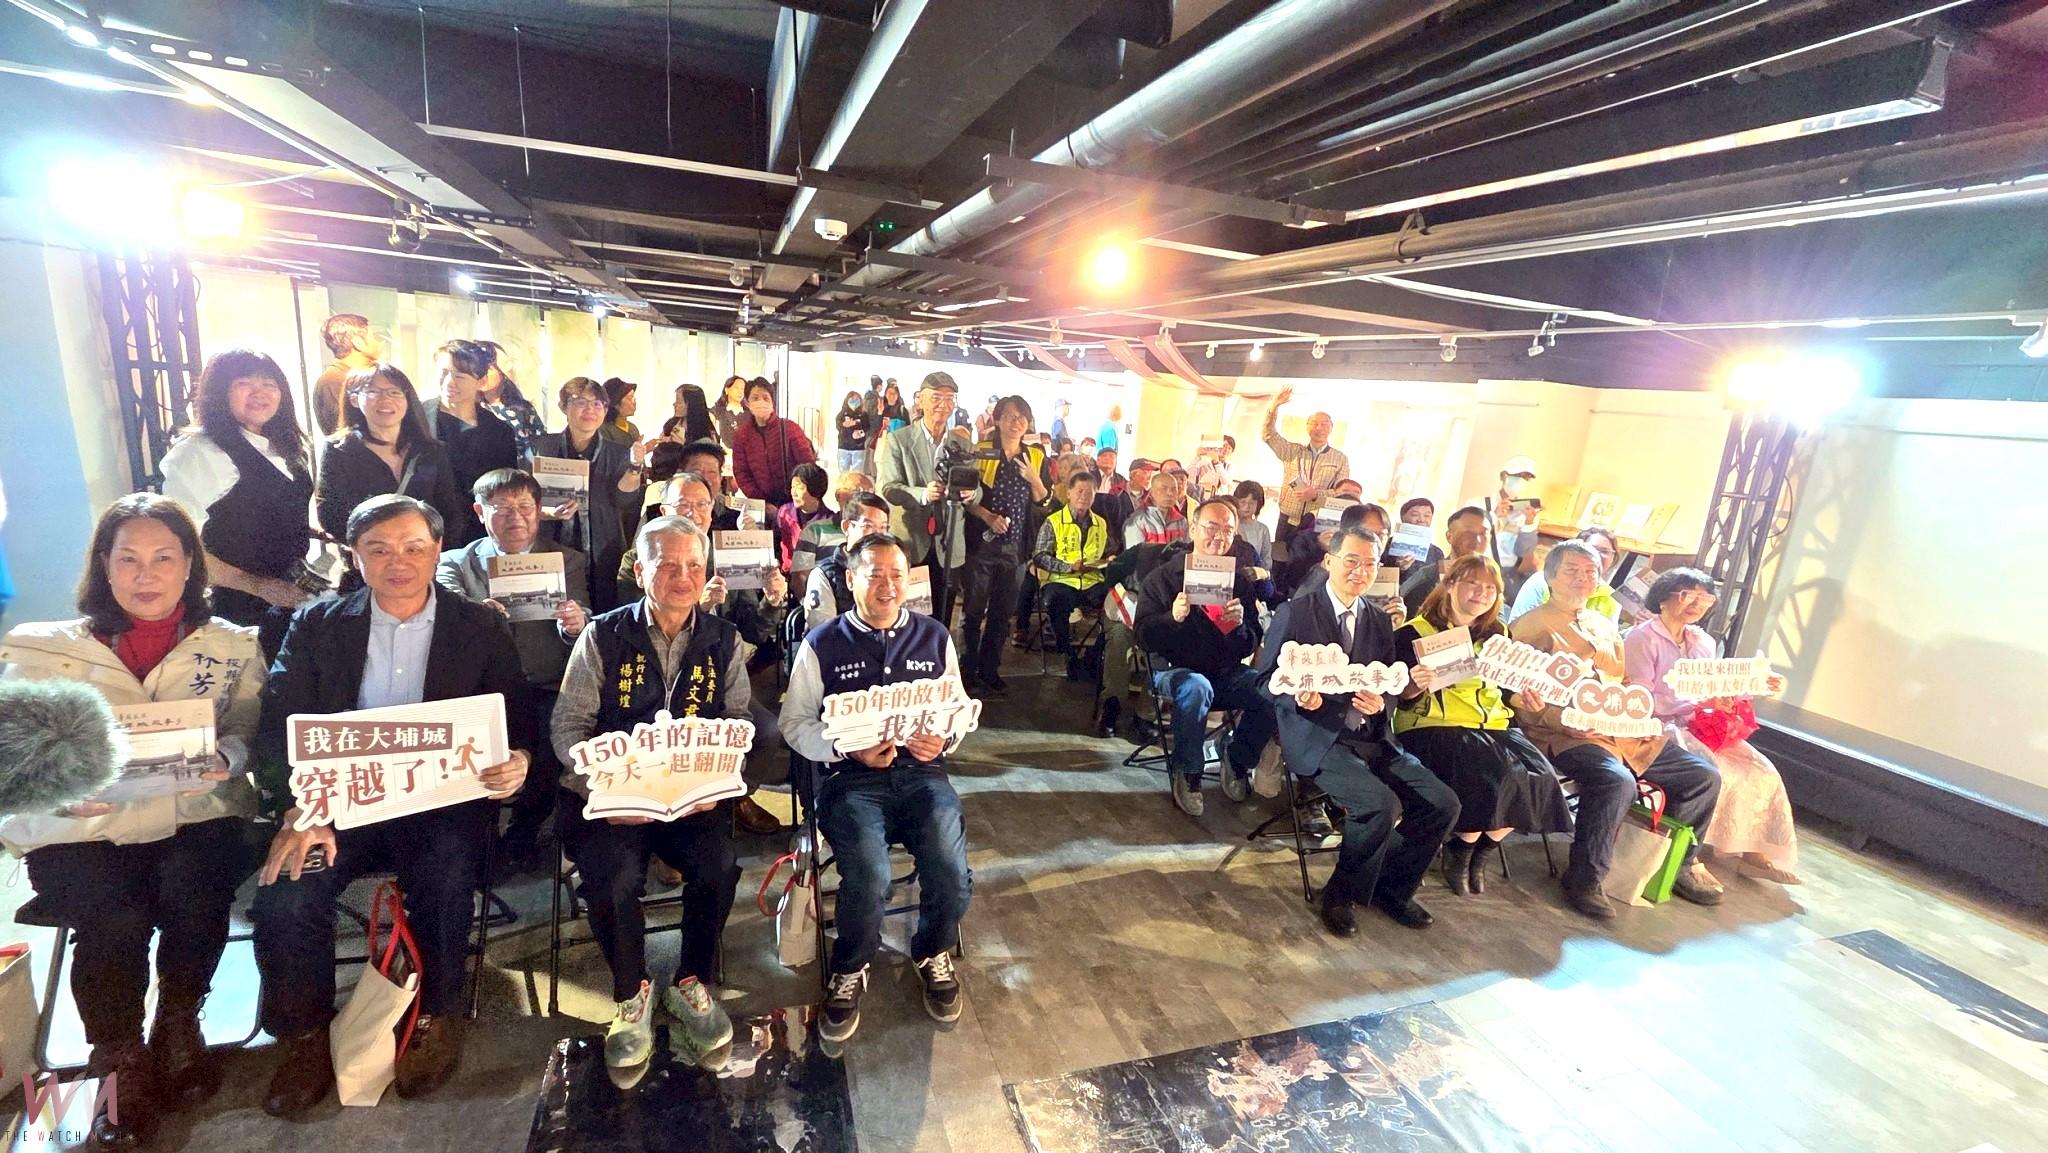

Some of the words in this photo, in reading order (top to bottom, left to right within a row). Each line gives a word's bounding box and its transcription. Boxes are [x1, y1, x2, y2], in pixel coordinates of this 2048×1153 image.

[905, 659, 936, 673] KMT
[303, 726, 448, 755] 我在大埔城
[593, 751, 739, 790] 今天一起翻開
